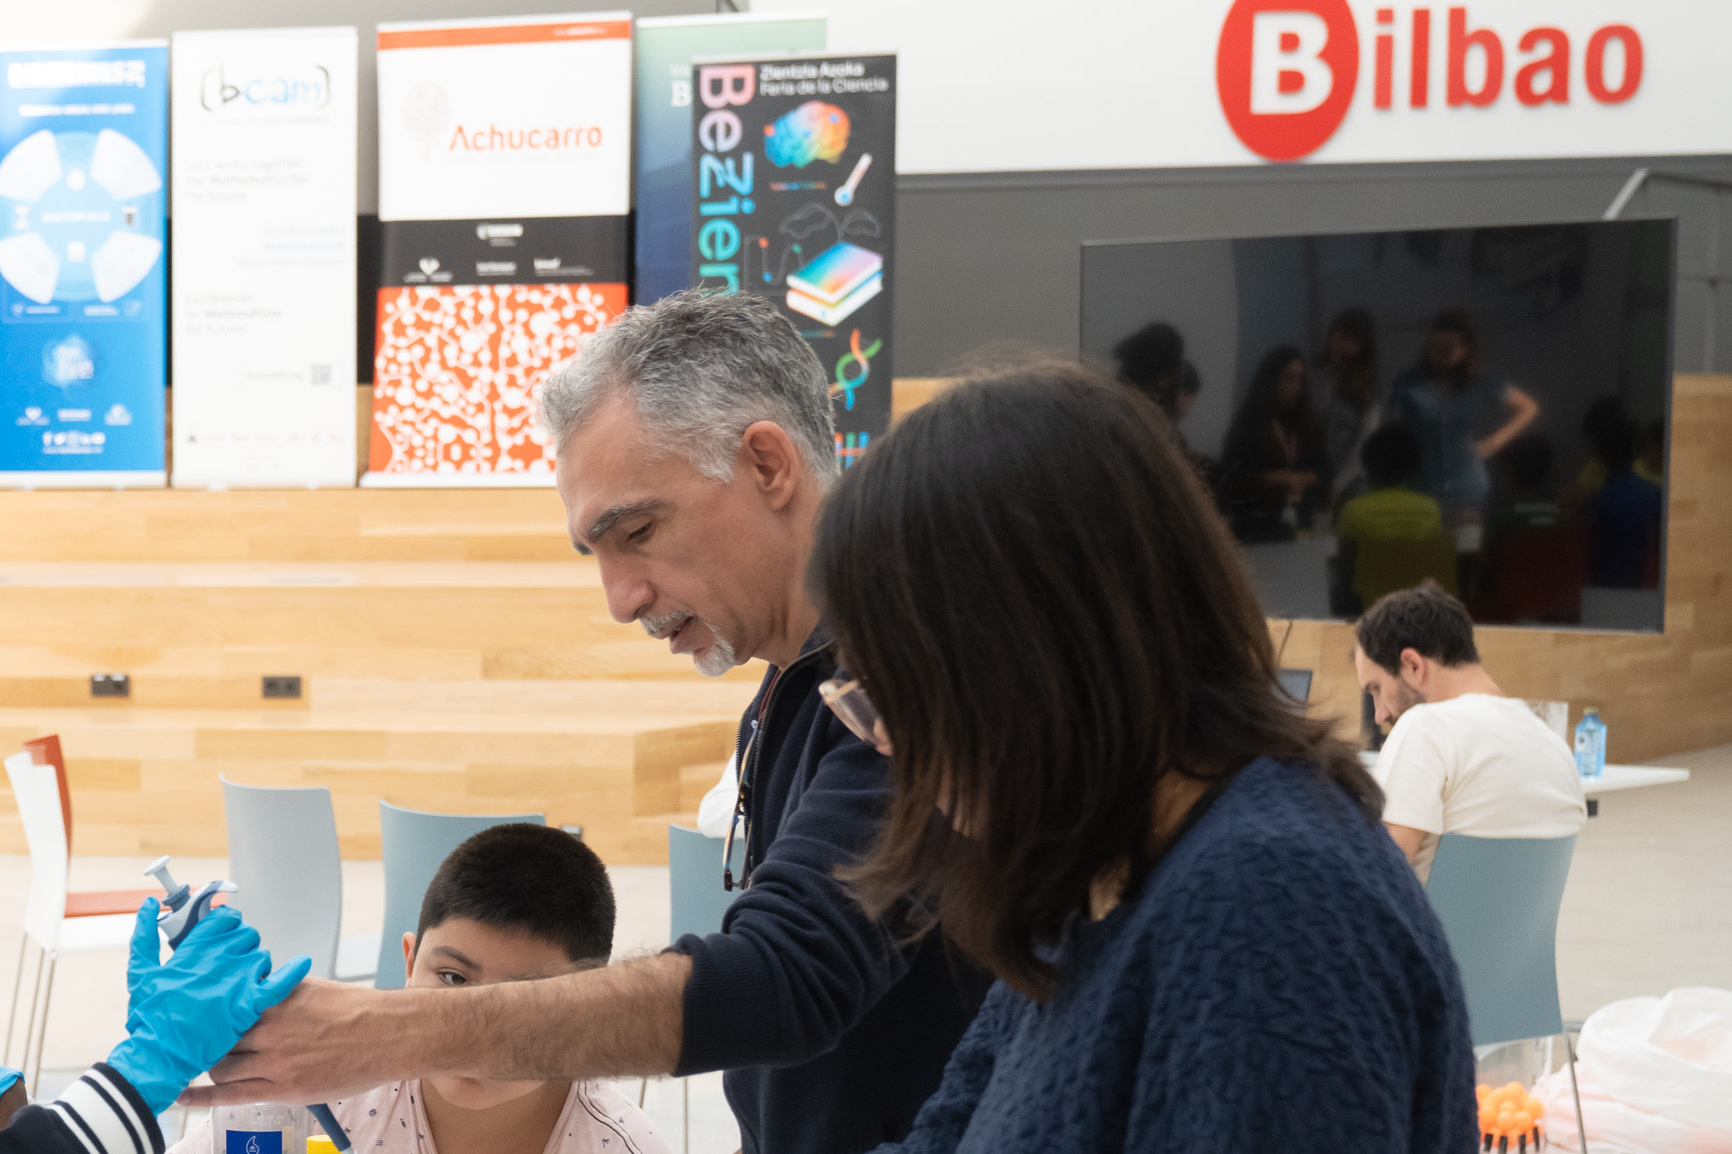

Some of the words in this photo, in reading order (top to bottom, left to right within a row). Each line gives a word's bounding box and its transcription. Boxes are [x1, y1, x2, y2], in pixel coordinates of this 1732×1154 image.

[819, 60, 865, 79] Azoka
[1250, 6, 1644, 114] Bilbao
[760, 80, 797, 97] Feria
[798, 79, 817, 96] de
[818, 78, 831, 95] la
[832, 74, 889, 95] Ciencia
[448, 122, 603, 153] Achucarro
